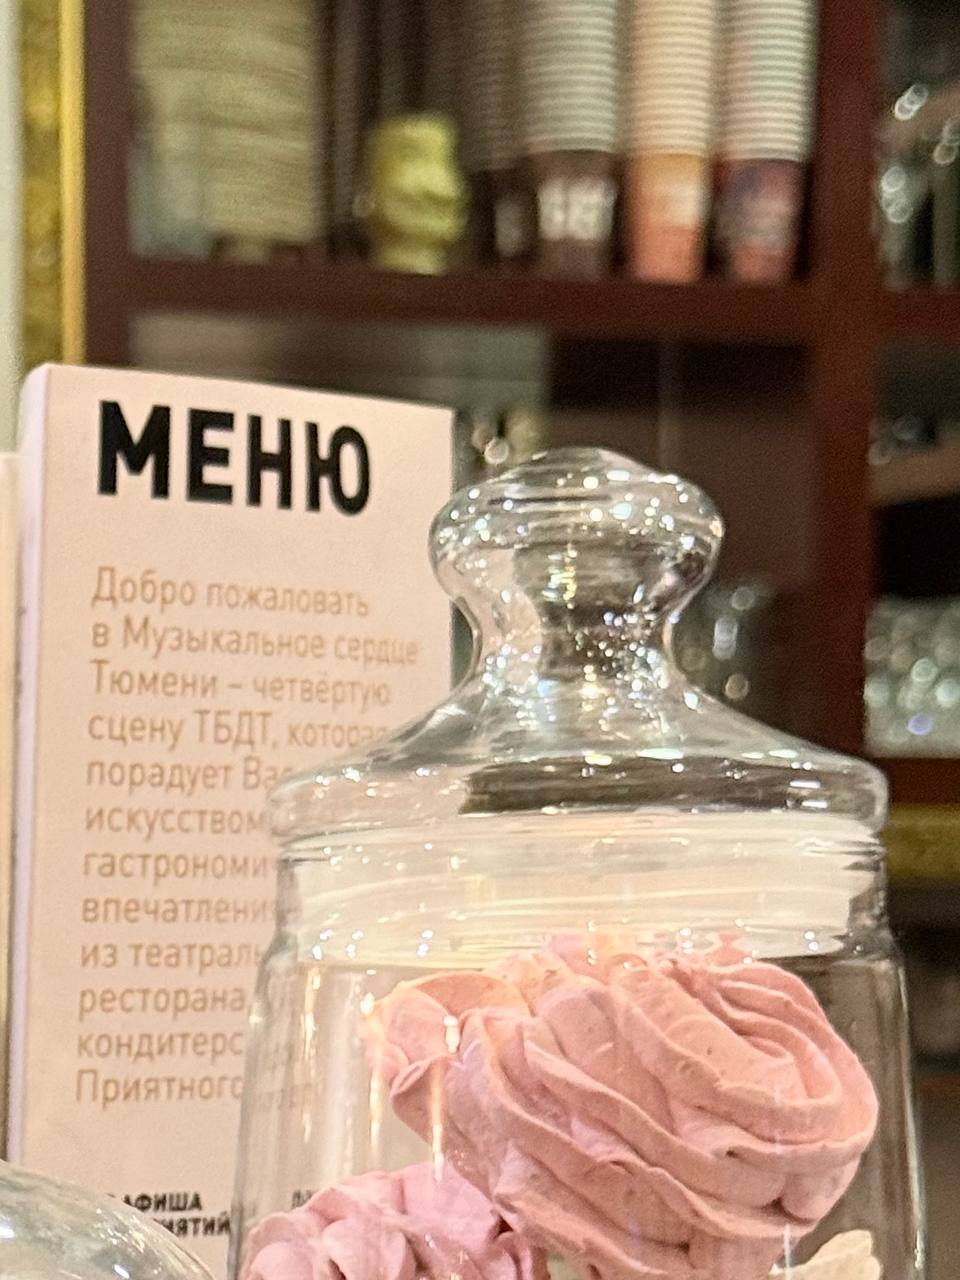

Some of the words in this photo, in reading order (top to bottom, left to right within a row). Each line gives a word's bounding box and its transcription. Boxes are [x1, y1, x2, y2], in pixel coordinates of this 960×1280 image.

[97, 400, 371, 516] МЕНЮ
[91, 566, 195, 612] Добро
[206, 582, 370, 617] пожаловать
[91, 622, 110, 648] в
[123, 615, 325, 659] Музыкальное
[334, 636, 419, 667] сердце
[89, 659, 218, 698] Тюмени
[88, 713, 185, 751] сцену
[193, 710, 278, 751] ТБДТ,
[86, 758, 233, 796] порадует
[84, 806, 269, 838] искусством
[83, 850, 274, 887] гастрономи
[81, 897, 275, 924] впечатлени
[80, 946, 118, 968] из
[77, 1032, 244, 1065] кондитерс
[76, 1069, 244, 1107] Приятного
